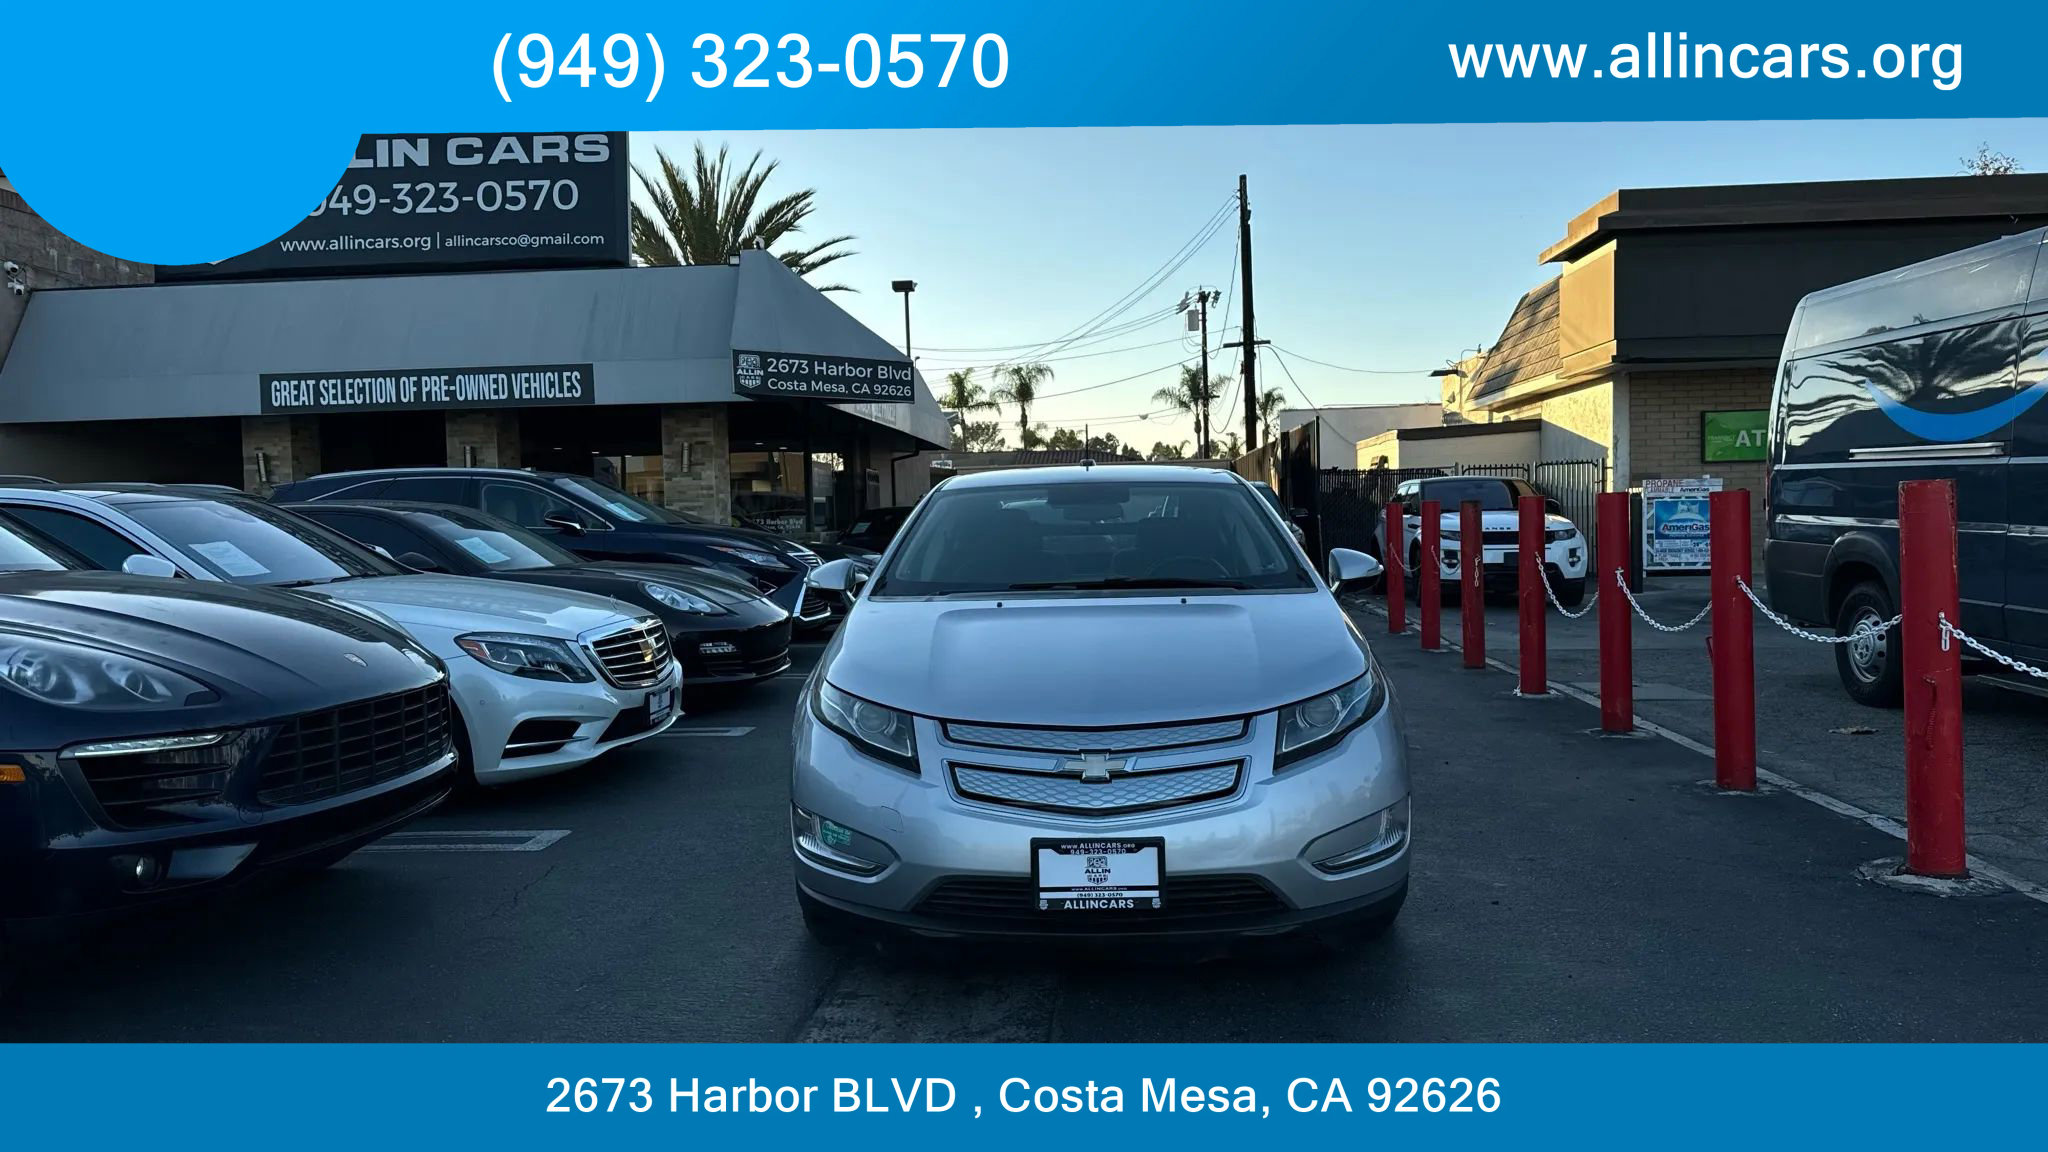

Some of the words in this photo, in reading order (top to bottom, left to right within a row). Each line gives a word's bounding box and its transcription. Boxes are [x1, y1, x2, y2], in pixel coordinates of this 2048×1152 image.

[446, 133, 610, 165] CARS
[280, 235, 431, 252] www.allincars.org
[445, 232, 604, 249] allincarsco@gmail.com
[736, 368, 764, 376] ALLIN
[767, 357, 809, 375] 2673
[814, 361, 873, 379] Harbor
[877, 365, 912, 381] Blvd
[271, 379, 316, 407] GREAT
[319, 376, 396, 406] SELECTION
[400, 375, 418, 403] OF
[421, 373, 508, 403] PRE-OWNED
[512, 370, 581, 400] VEHICLES
[767, 378, 807, 392] Costa
[811, 380, 849, 394] Mesa,
[852, 383, 871, 395] CA
[873, 384, 912, 397] 92626
[1735, 429, 1767, 447] AT
[1645, 480, 1685, 488] PROPANE
[1662, 523, 1710, 532] AmeriGas
[1064, 899, 1134, 909] ALLINCARS
